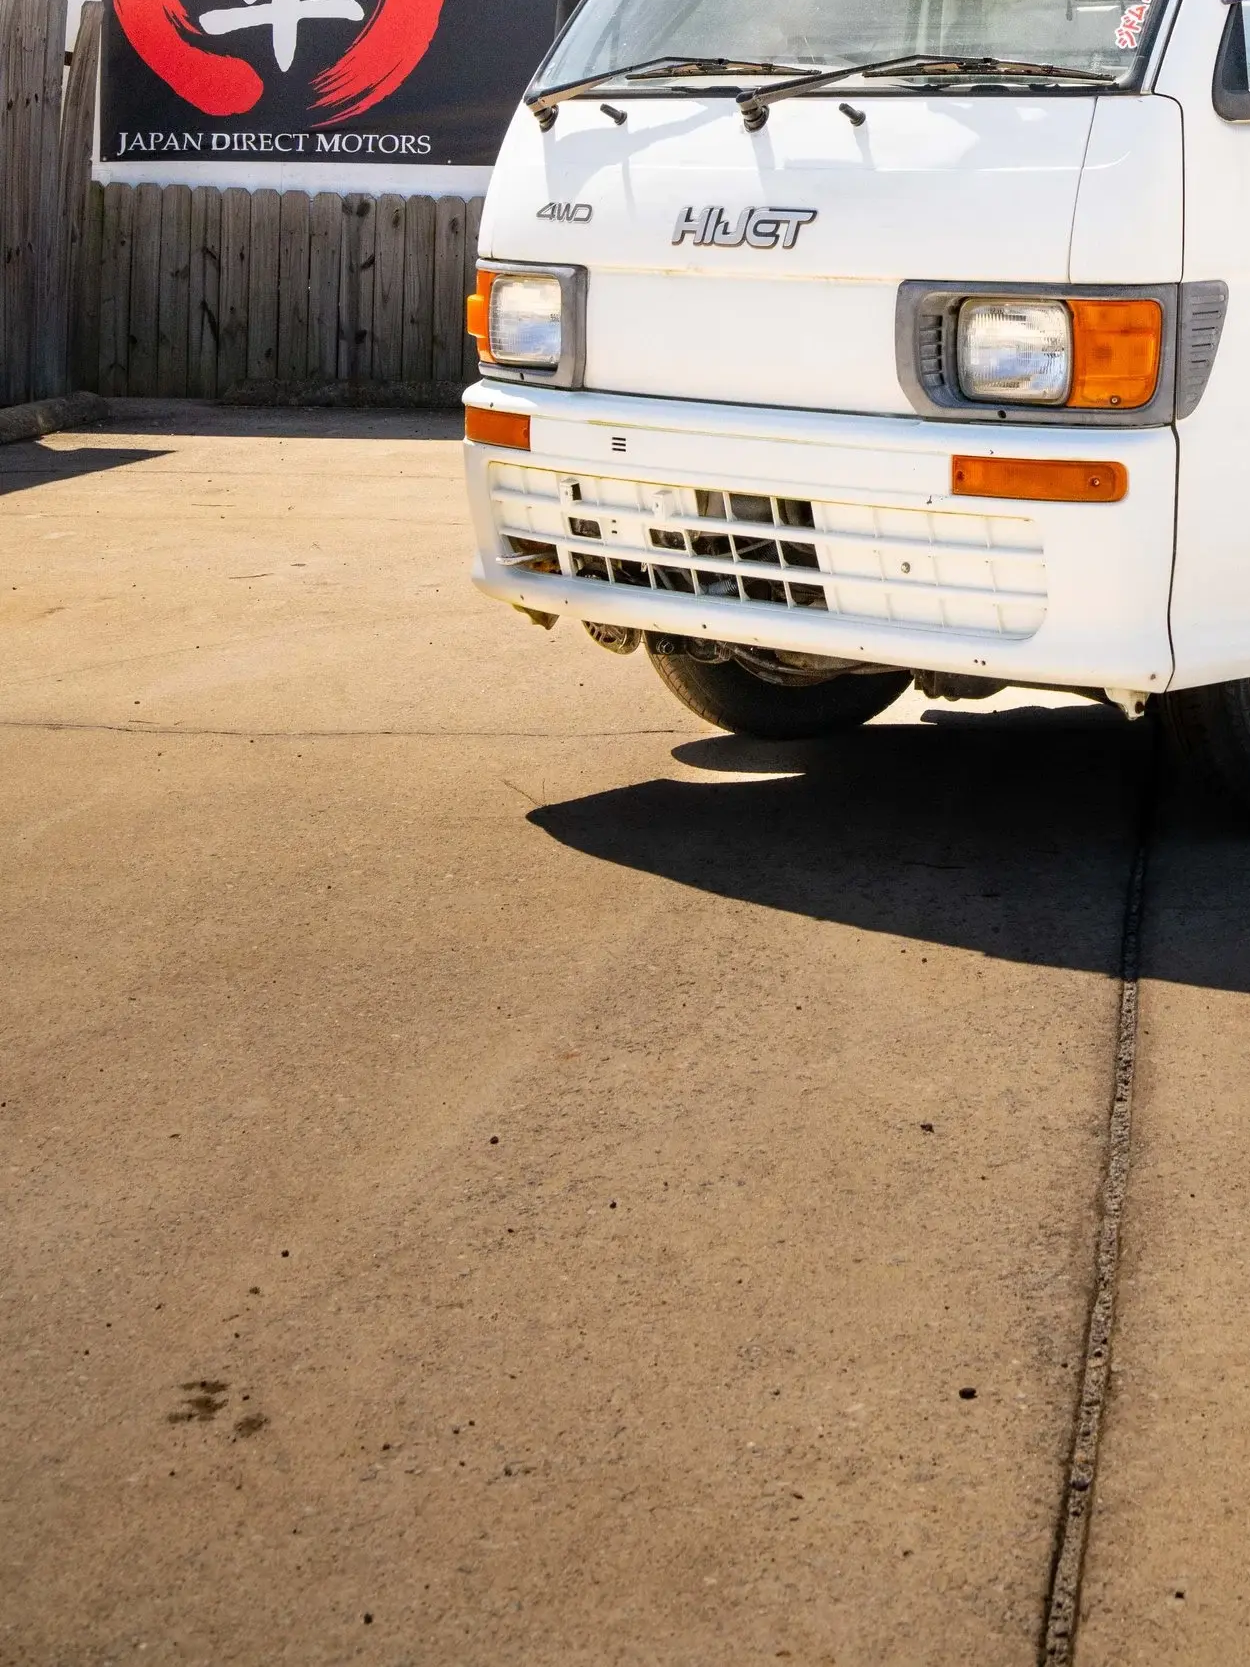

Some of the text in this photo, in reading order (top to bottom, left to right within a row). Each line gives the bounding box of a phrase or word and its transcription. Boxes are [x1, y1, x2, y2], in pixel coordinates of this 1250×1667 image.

[116, 131, 432, 156] JAPAN DIRECT MOTORS
[536, 202, 594, 223] 4WD
[671, 205, 818, 250] HIJET
